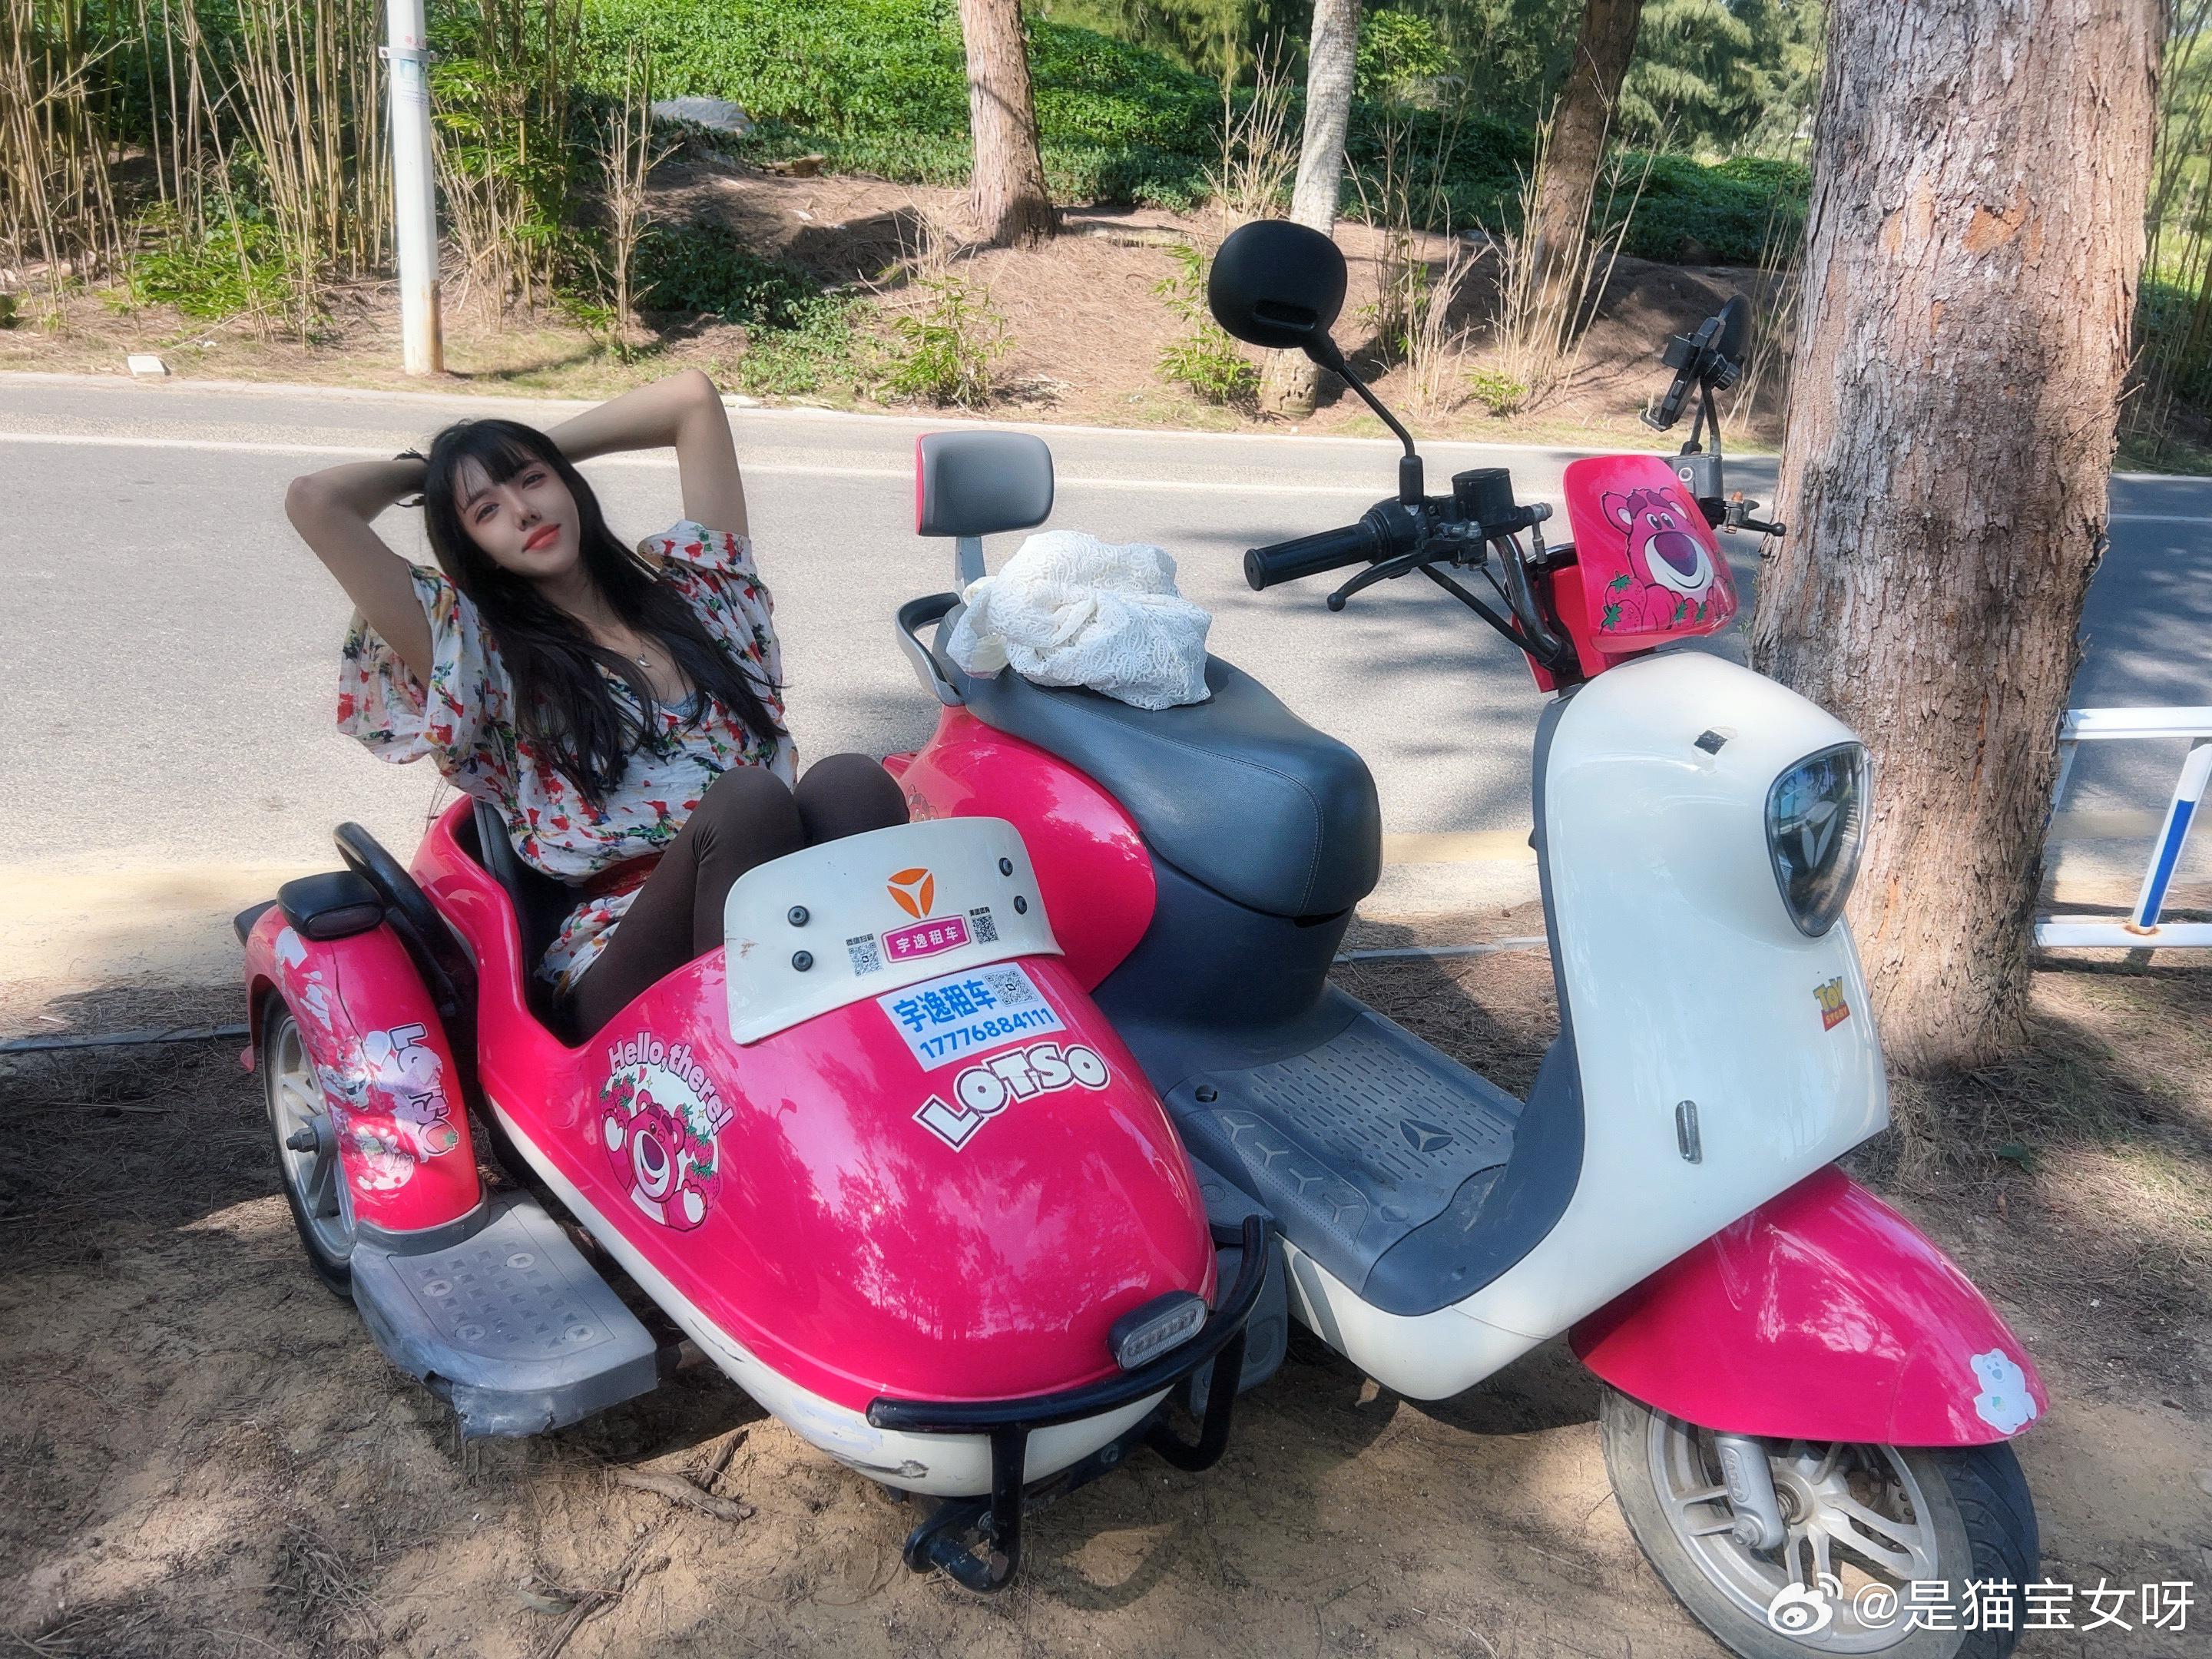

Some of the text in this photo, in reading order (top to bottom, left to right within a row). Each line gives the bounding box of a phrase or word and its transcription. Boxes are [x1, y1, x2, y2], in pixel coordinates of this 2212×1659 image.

[896, 926, 958, 953] 宇逸租车
[892, 979, 998, 1033] 宇逸租车
[1813, 976, 1843, 1012] TOY
[919, 1008, 1055, 1058] 17776884111
[914, 1042, 1109, 1150] LOTSO
